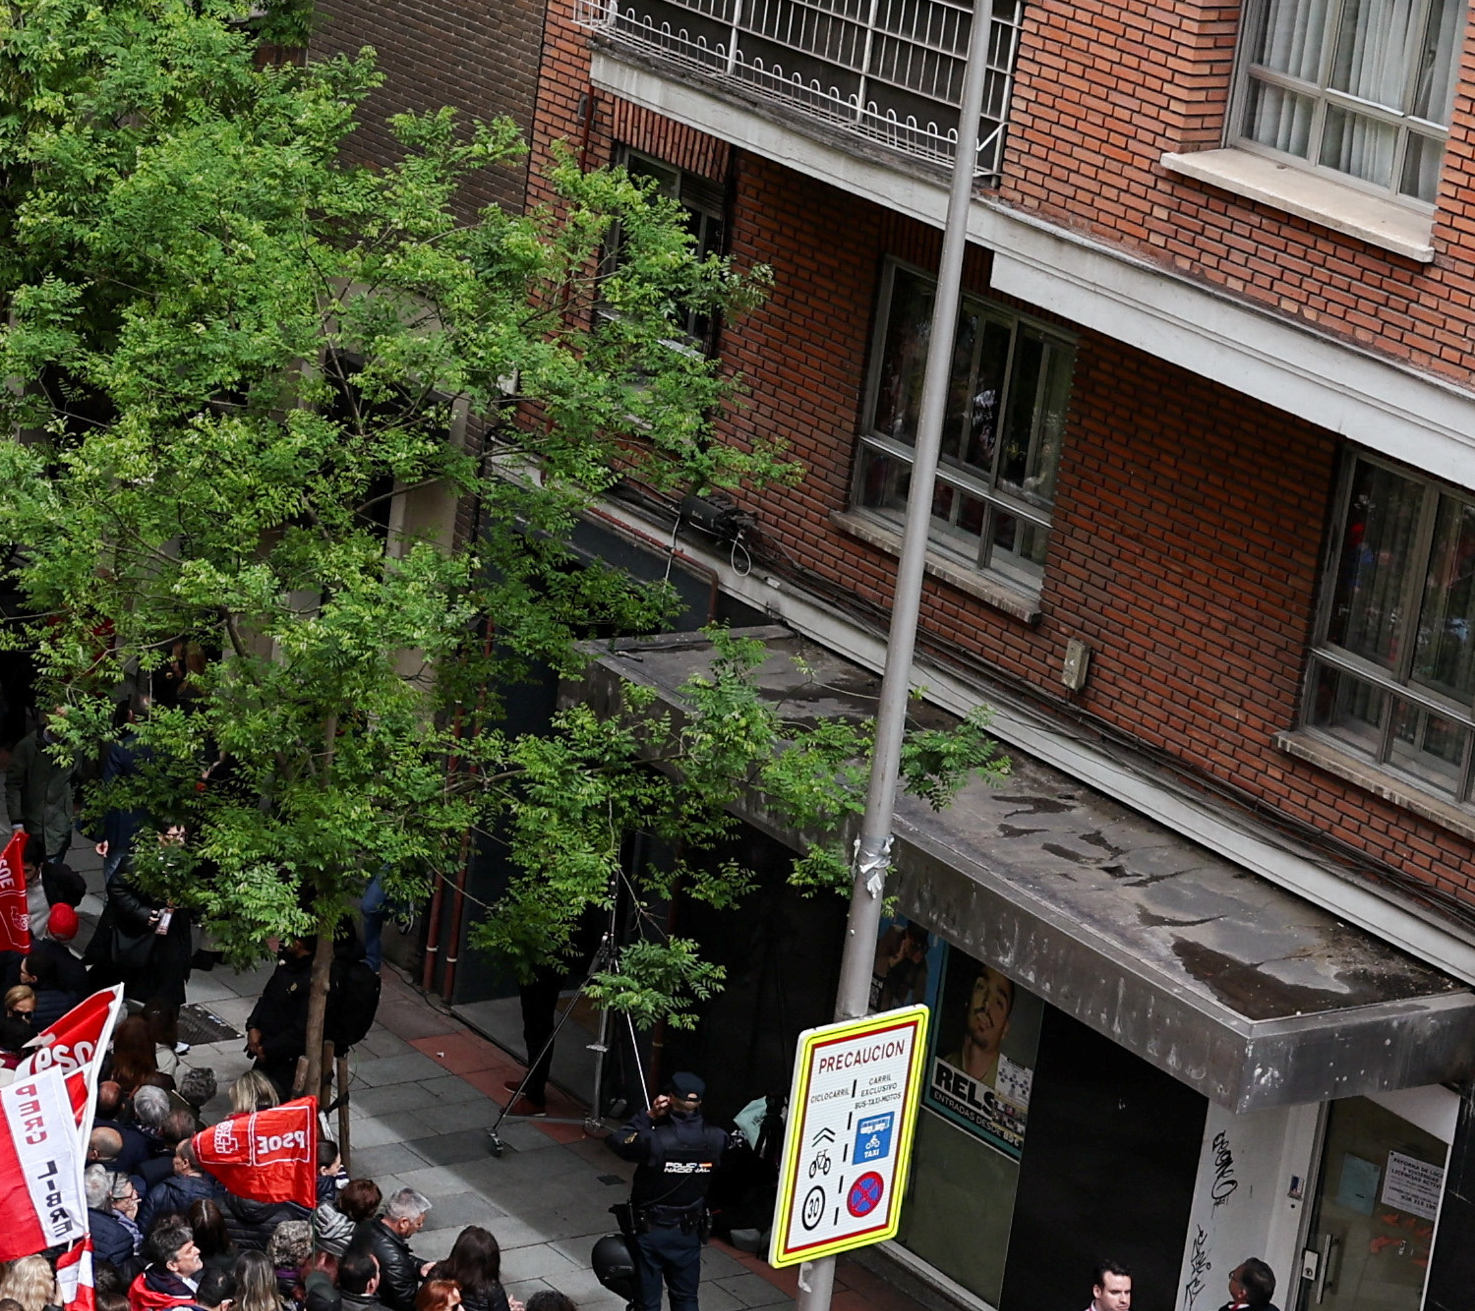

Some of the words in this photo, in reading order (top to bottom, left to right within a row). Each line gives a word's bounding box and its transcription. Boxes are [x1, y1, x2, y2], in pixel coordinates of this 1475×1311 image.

[818, 1039, 906, 1075] PRECAUCION
[868, 1073, 893, 1086] CARRIL
[810, 1088, 850, 1104] CICLOCARRIL
[860, 1082, 899, 1098] EXCLUSIVO
[854, 1092, 902, 1110] BUS-TAXI-MOTOS
[933, 1090, 977, 1124] ENTRADAS
[975, 1116, 1002, 1138] DESDE
[863, 1149, 880, 1159] TAXI
[807, 1198, 821, 1220] 30
